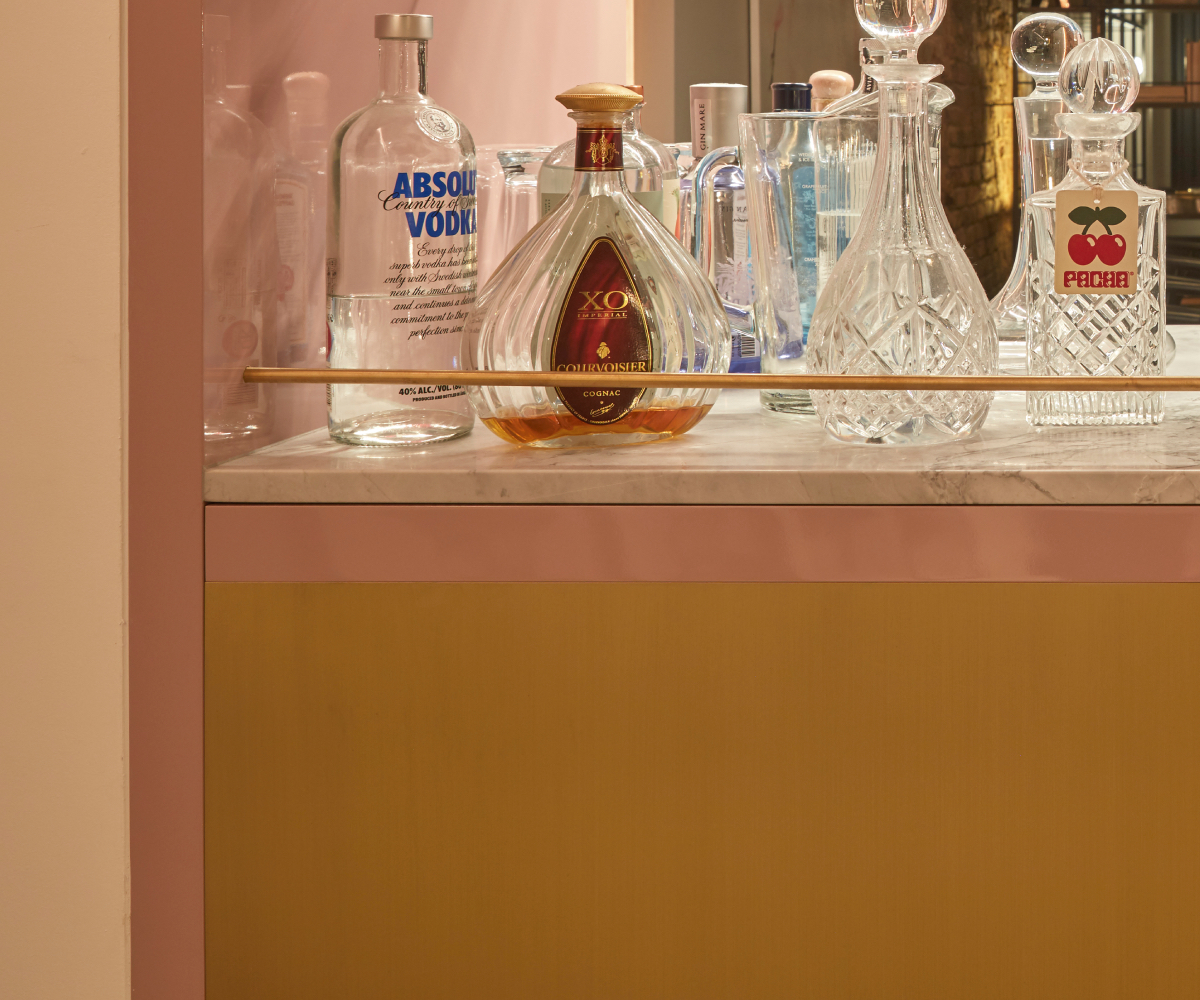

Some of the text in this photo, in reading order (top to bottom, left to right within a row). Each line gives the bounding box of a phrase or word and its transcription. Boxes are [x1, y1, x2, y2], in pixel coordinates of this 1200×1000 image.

[698, 103, 706, 131] MARE
[377, 189, 445, 218] Country
[446, 193, 462, 216] of
[416, 242, 447, 262] Every
[389, 259, 420, 273] superb
[421, 259, 446, 269] vodka
[447, 256, 460, 267] has
[383, 273, 406, 289] only
[407, 272, 427, 283] with
[427, 269, 462, 284] Swedish
[389, 288, 410, 297] near
[412, 286, 425, 296] the
[427, 284, 451, 295] small
[391, 300, 414, 311] and
[414, 299, 454, 310] continues
[577, 290, 629, 310] XO
[390, 311, 447, 324] commitment
[408, 325, 449, 340] perfection
[556, 361, 647, 372] COURVOISIER
[399, 387, 416, 396] 40%
[583, 389, 621, 398] COGNAC
